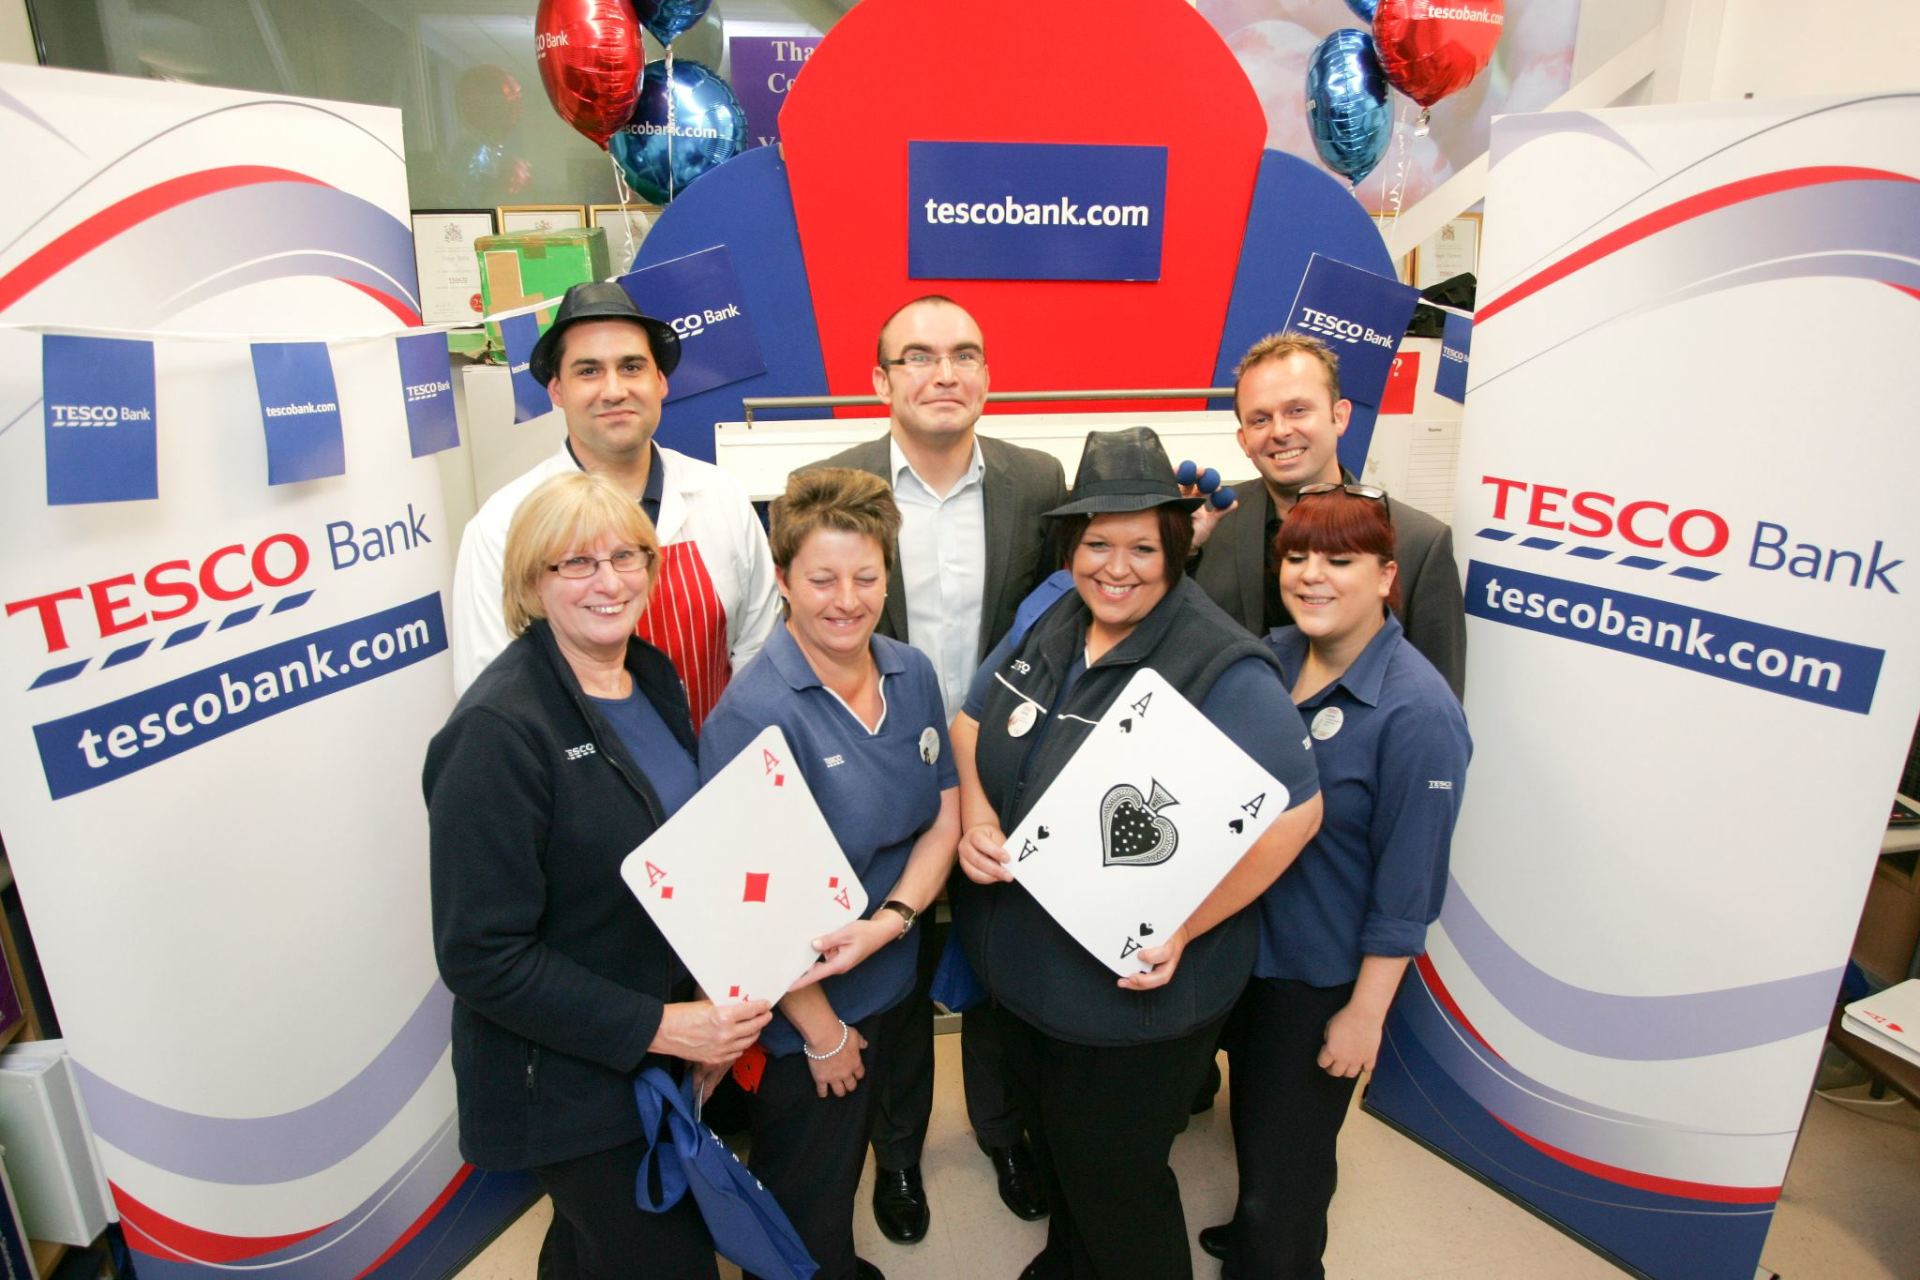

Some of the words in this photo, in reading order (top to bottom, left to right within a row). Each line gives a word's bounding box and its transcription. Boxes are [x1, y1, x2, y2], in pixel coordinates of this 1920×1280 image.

[546, 30, 569, 49] Bank
[925, 195, 1149, 227] tescobank.com
[703, 303, 741, 325] Bank
[1302, 307, 1363, 338] TESCO
[1363, 328, 1394, 349] Bank
[1443, 346, 1464, 360] TESCO
[404, 382, 437, 397] TESCO
[437, 381, 450, 392] Bank
[51, 405, 118, 421] TESCO
[120, 407, 151, 421] Bank
[265, 401, 337, 417] tescobank.com
[1482, 475, 1730, 559] TESCO
[1749, 521, 1904, 594] Bank
[5, 532, 311, 654] TESCO
[326, 503, 432, 570] Bank
[1485, 577, 1842, 692] tescobank.com
[78, 615, 430, 769] tescobank.com
[1131, 692, 1153, 718] A
[763, 749, 779, 775] A
[1241, 793, 1266, 819] A
[1018, 838, 1038, 862] A
[645, 861, 667, 887] A
[834, 887, 850, 910] A
